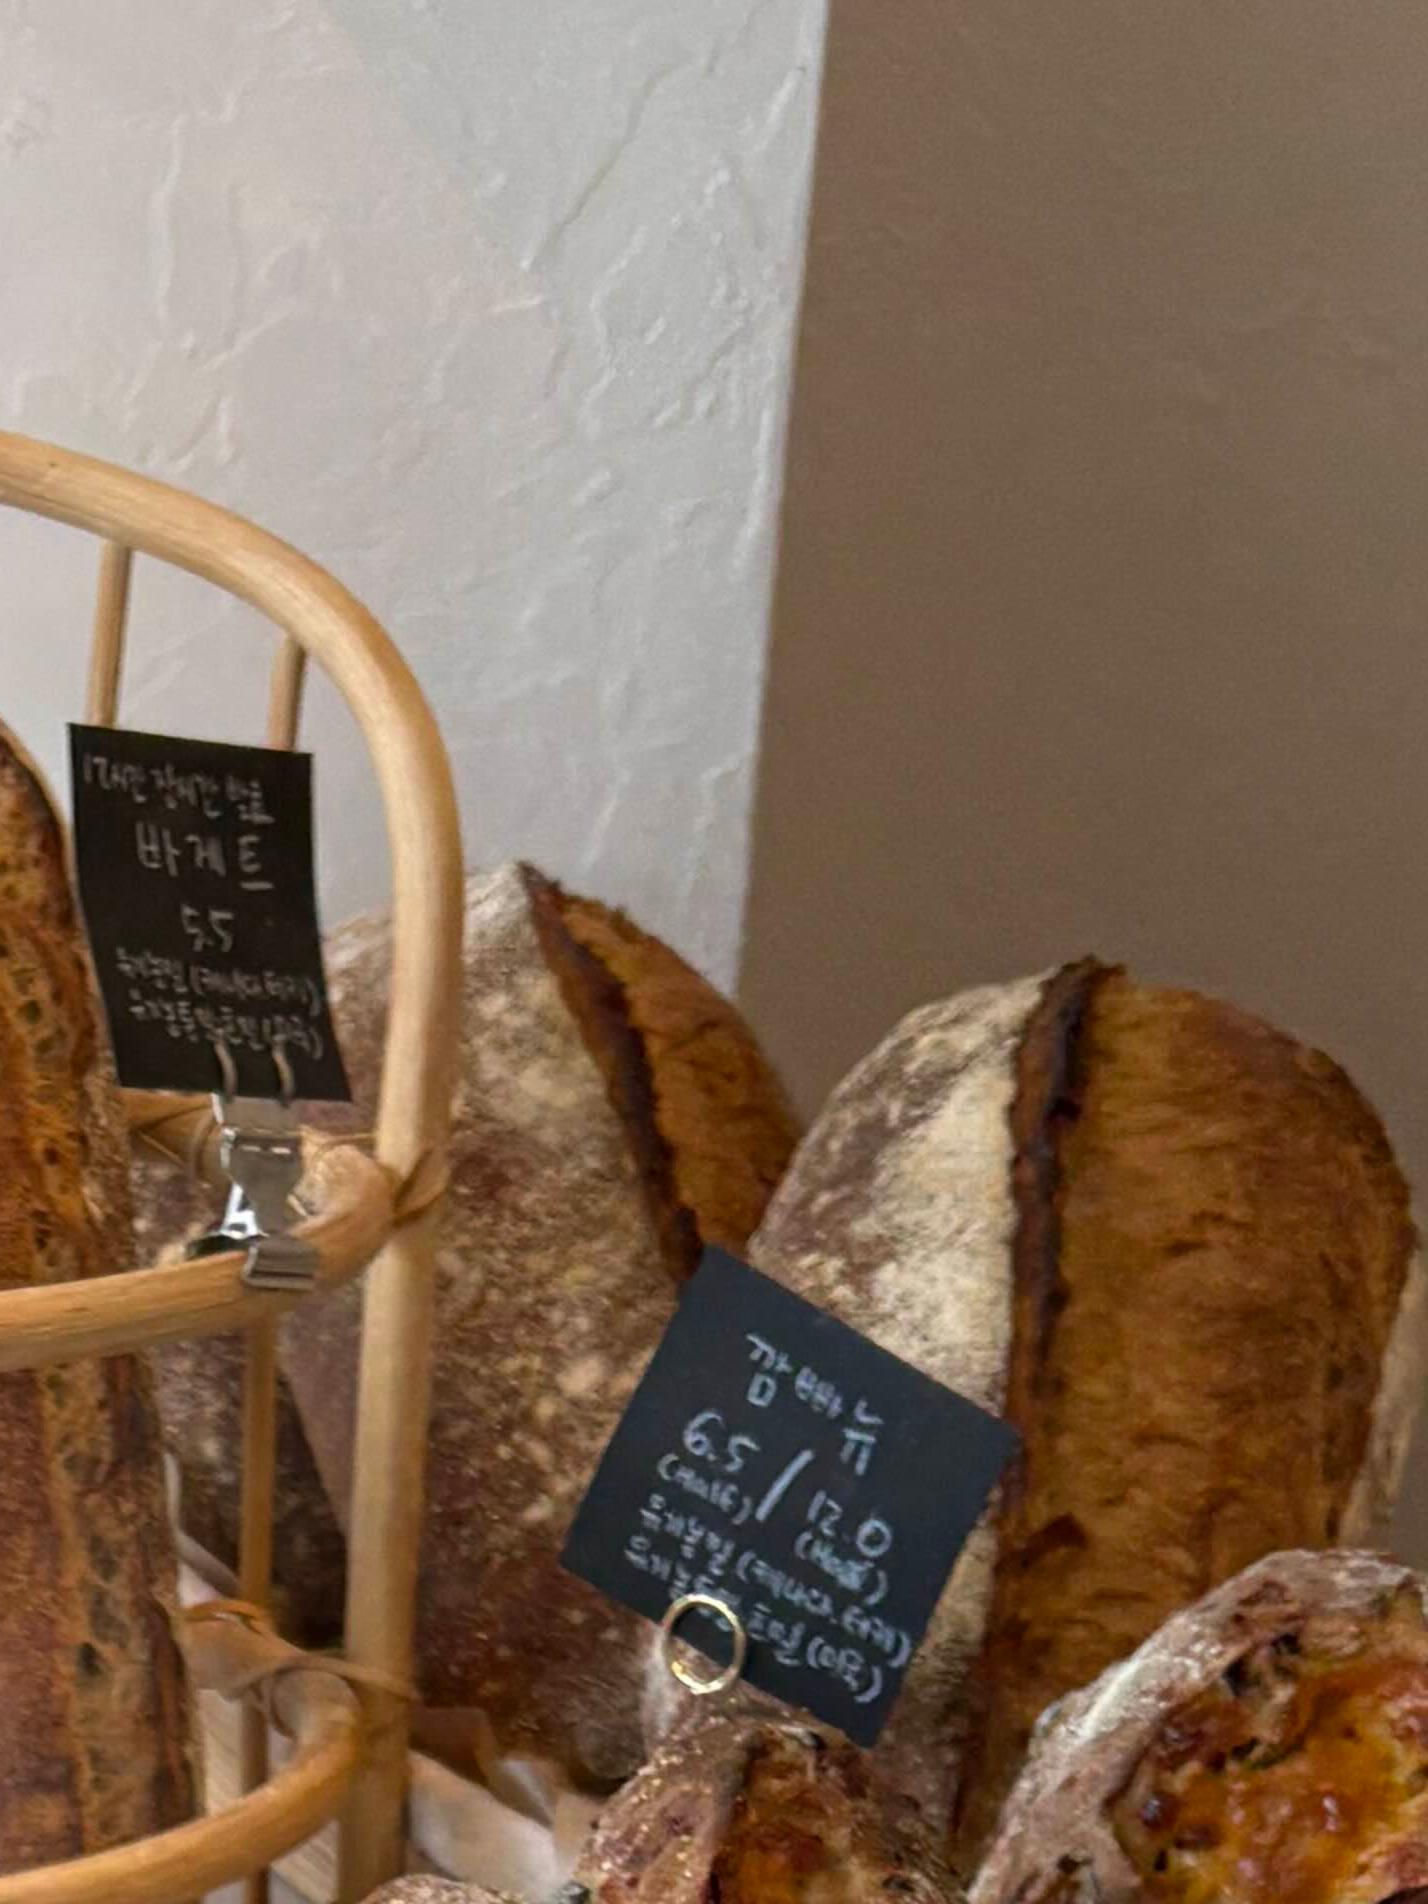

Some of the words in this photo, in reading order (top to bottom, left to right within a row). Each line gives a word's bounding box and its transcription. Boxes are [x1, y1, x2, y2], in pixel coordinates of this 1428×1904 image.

[134, 820, 275, 891] 바게트
[744, 1331, 886, 1477] 깜빠뉴
[681, 1407, 762, 1474] 6.5
